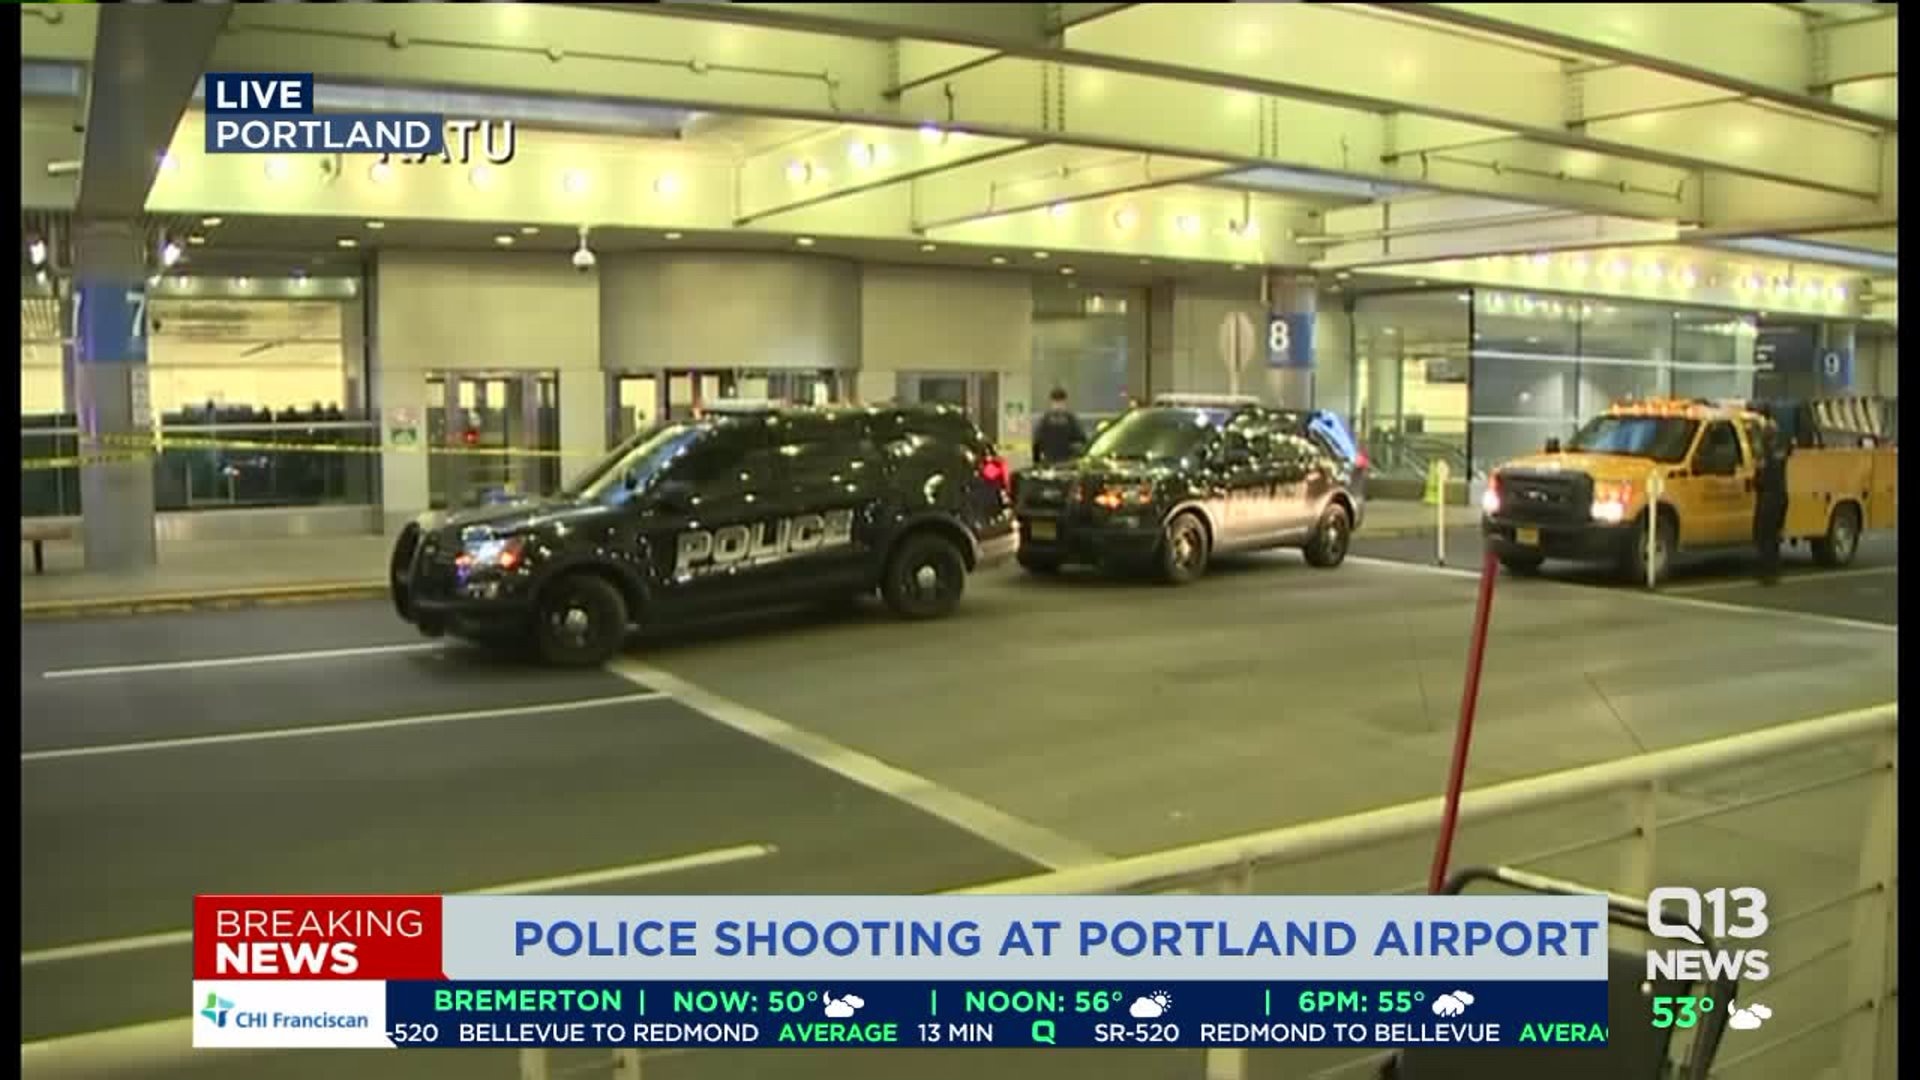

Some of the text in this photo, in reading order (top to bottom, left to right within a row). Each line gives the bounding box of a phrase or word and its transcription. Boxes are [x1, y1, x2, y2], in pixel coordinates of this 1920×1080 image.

[1269, 319, 1290, 352] 8
[1823, 353, 1841, 376] 9
[674, 508, 854, 578] POLICE
